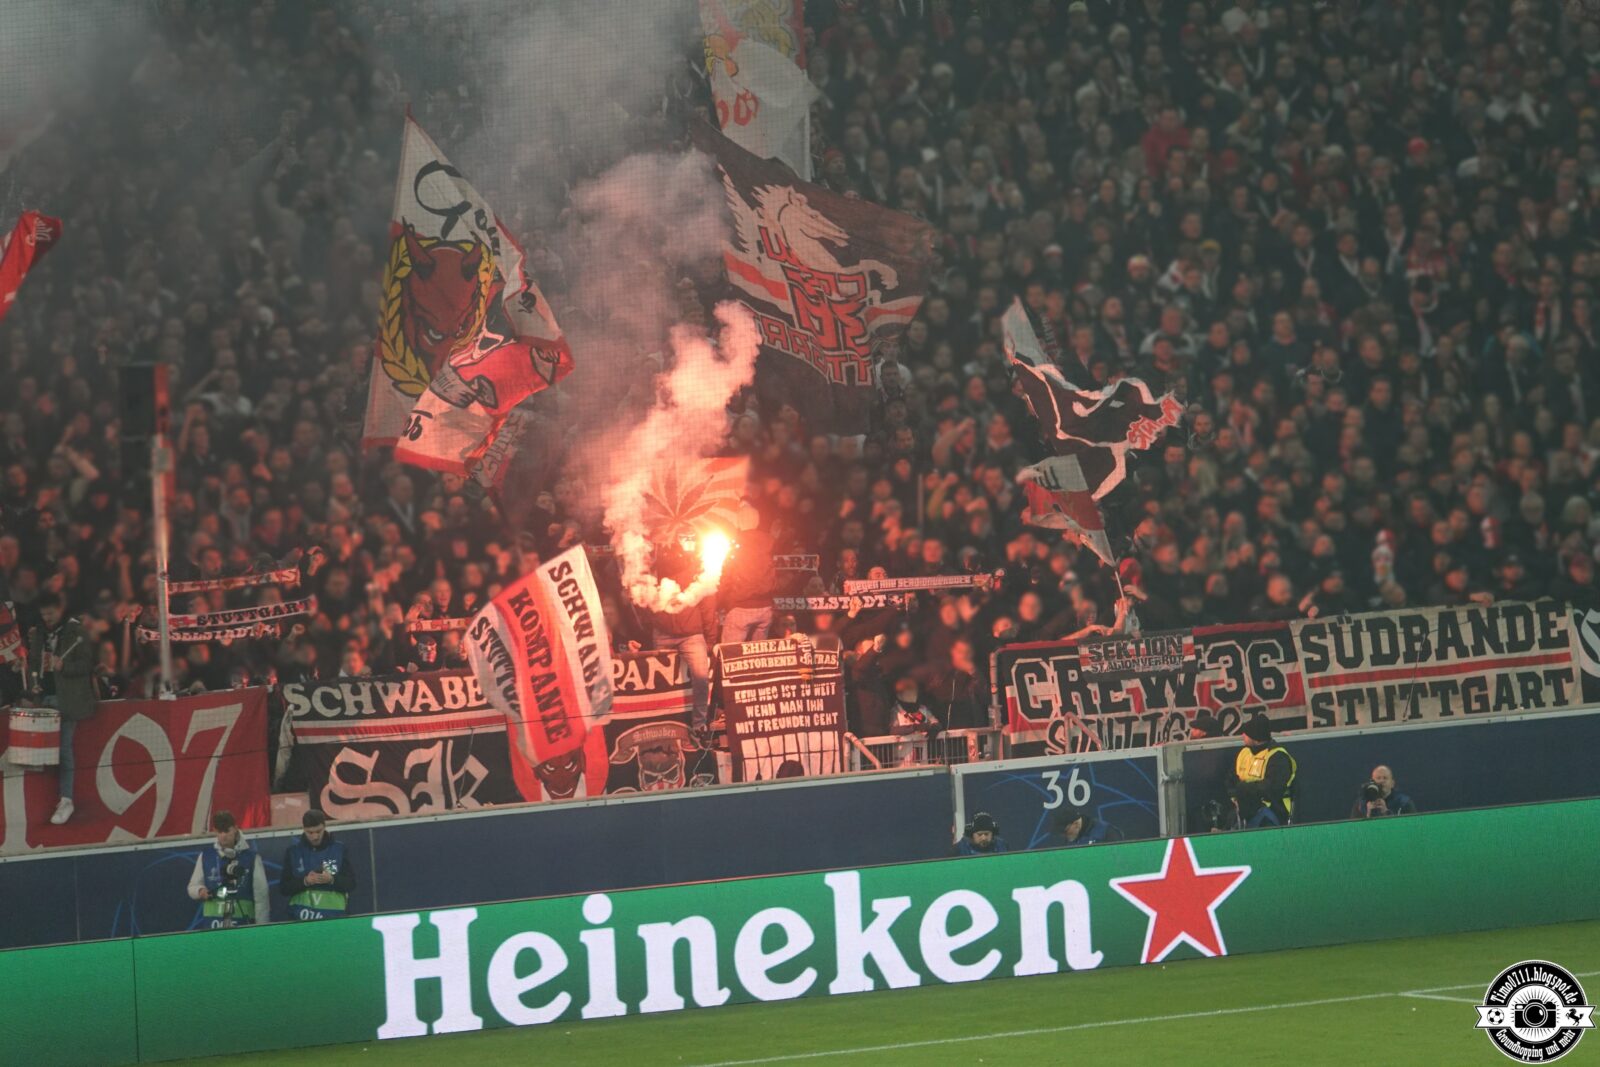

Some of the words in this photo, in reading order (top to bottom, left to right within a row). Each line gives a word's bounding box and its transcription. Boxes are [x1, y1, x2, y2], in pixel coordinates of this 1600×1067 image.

[741, 643, 776, 655] EHRE
[1088, 633, 1183, 662] SEKTION
[1300, 601, 1571, 674] SÜDBANDE
[781, 684, 797, 697] IST
[1207, 639, 1291, 705] 36
[283, 675, 490, 716] SCHWABE
[779, 700, 804, 713] MAN
[1311, 667, 1574, 728] STUTTGART
[735, 721, 755, 734] MIT
[757, 715, 811, 732] FREUNDEN
[1041, 768, 1092, 810] 36
[370, 870, 1105, 1041] Heineken
